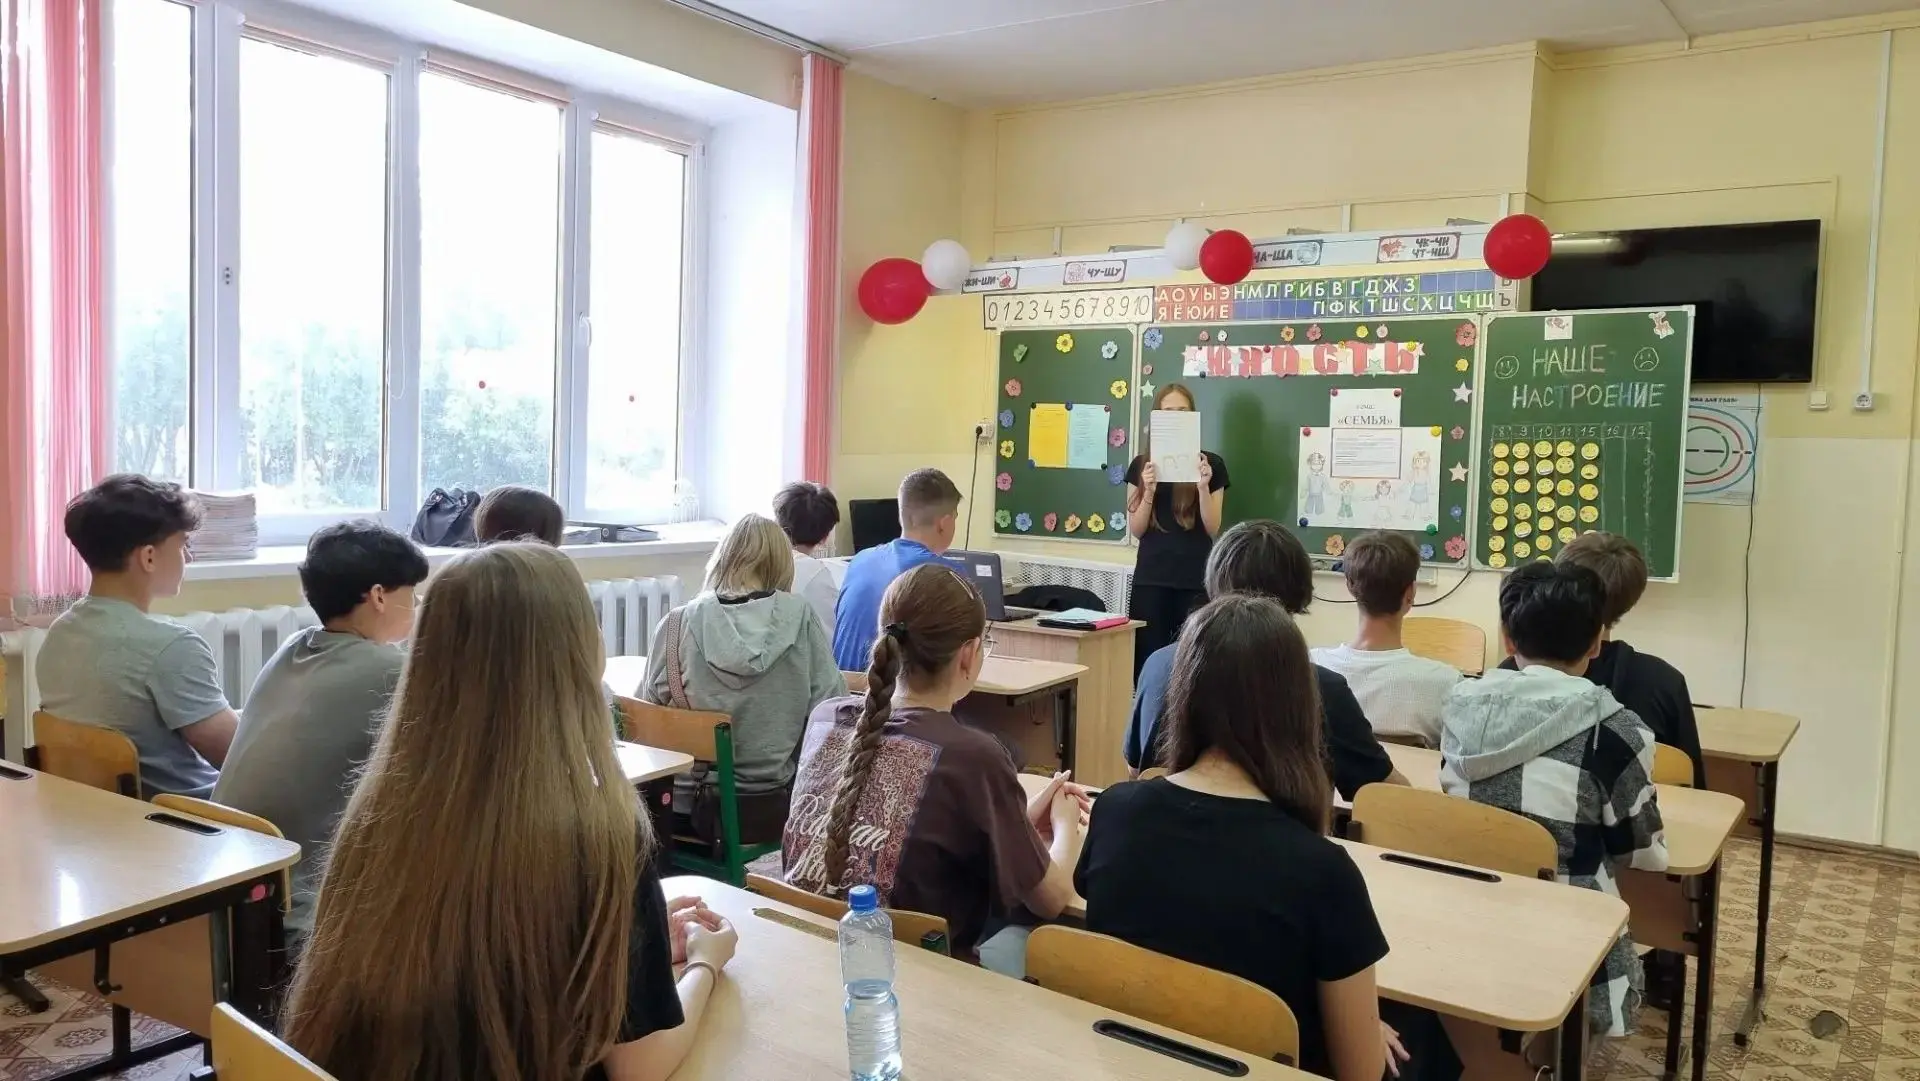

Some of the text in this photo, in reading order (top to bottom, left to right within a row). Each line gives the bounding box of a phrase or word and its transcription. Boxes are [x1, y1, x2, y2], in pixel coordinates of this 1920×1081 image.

[1532, 344, 1608, 377] НАШЕ
[1511, 381, 1667, 409] НАСТРОЕНИЕ
[1337, 415, 1393, 425] «СЕМЬЯ»
[1538, 425, 1553, 438] 10
[1581, 426, 1597, 437] 15
